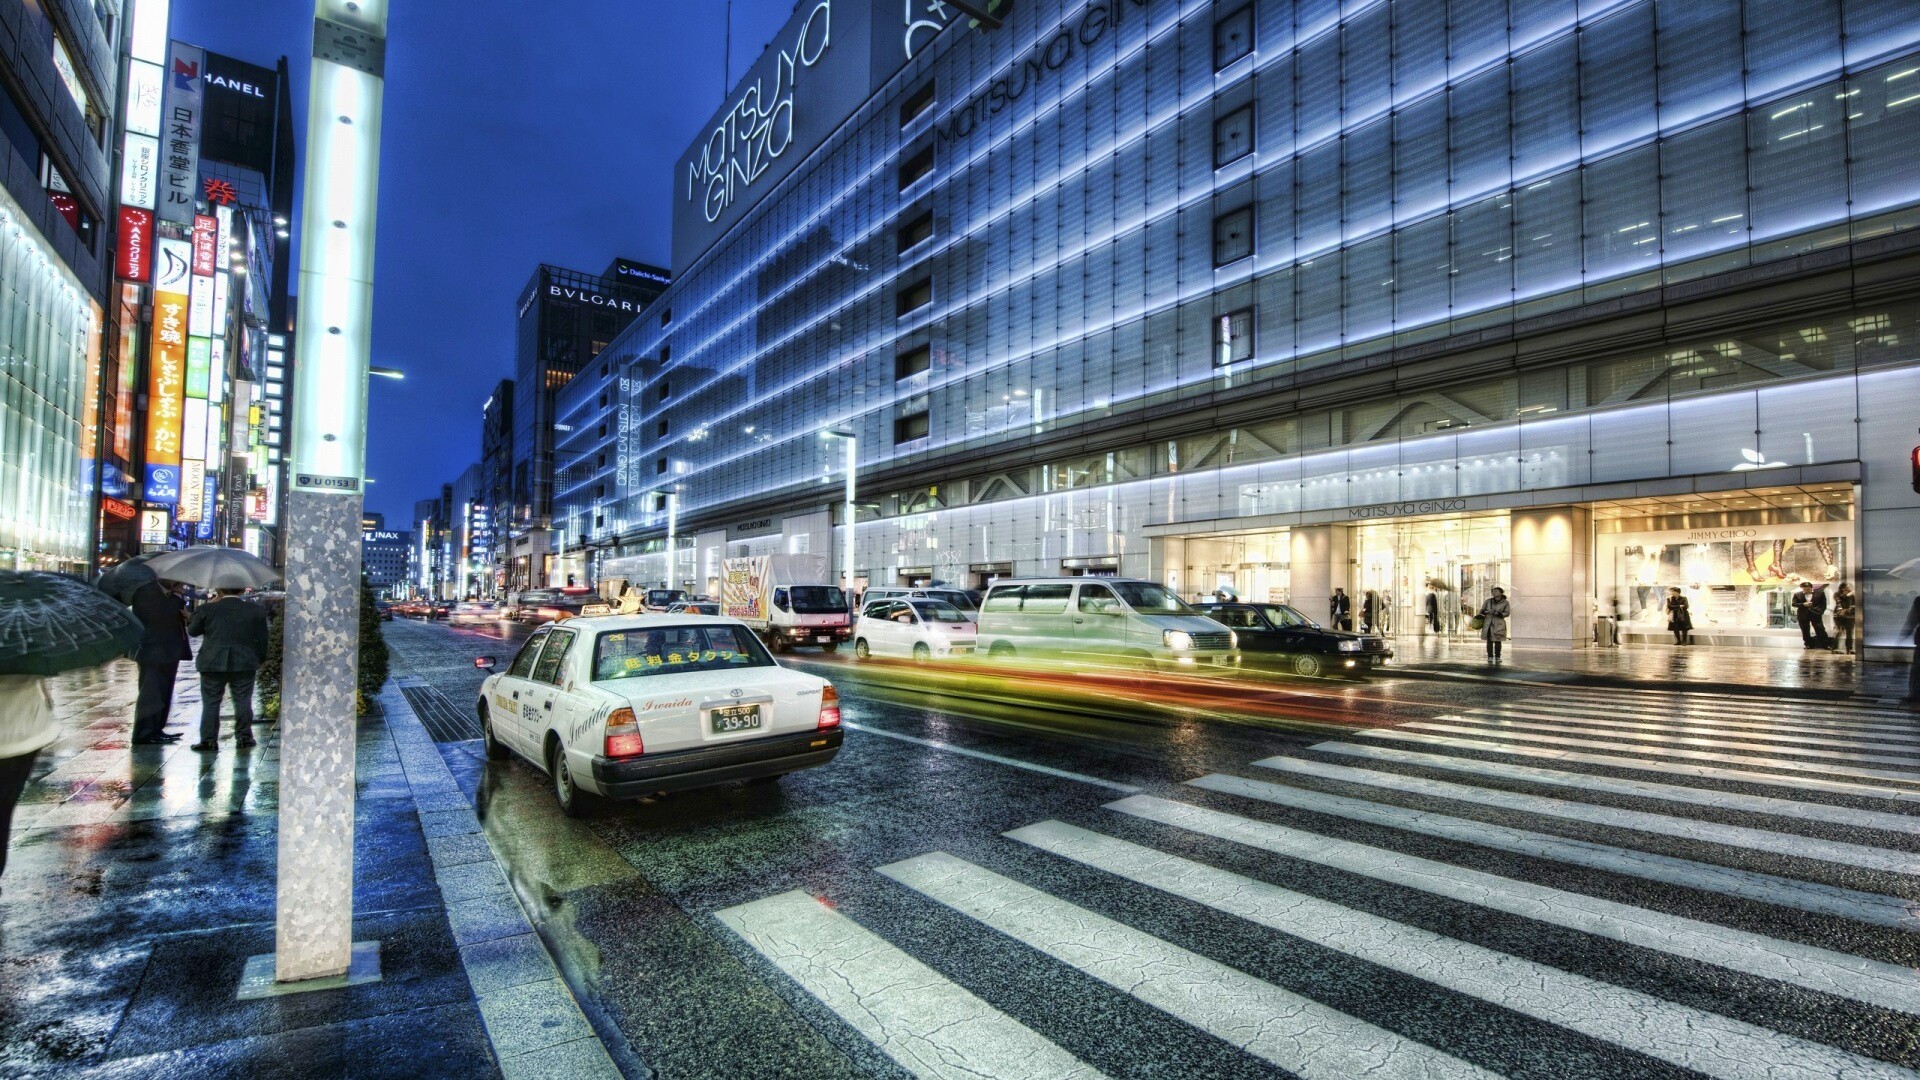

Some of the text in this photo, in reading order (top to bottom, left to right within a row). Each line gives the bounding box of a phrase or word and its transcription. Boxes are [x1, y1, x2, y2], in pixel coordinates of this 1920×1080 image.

[204, 74, 264, 98] HANEL
[168, 106, 193, 204] 日本香堂ビル
[550, 285, 641, 313] BVLGARI
[325, 479, 349, 487] 0153
[375, 532, 398, 540] INAX
[1687, 529, 1757, 540] JIMMY CHOO
[723, 707, 750, 717] 足立 500
[722, 714, 758, 730] 39-90
